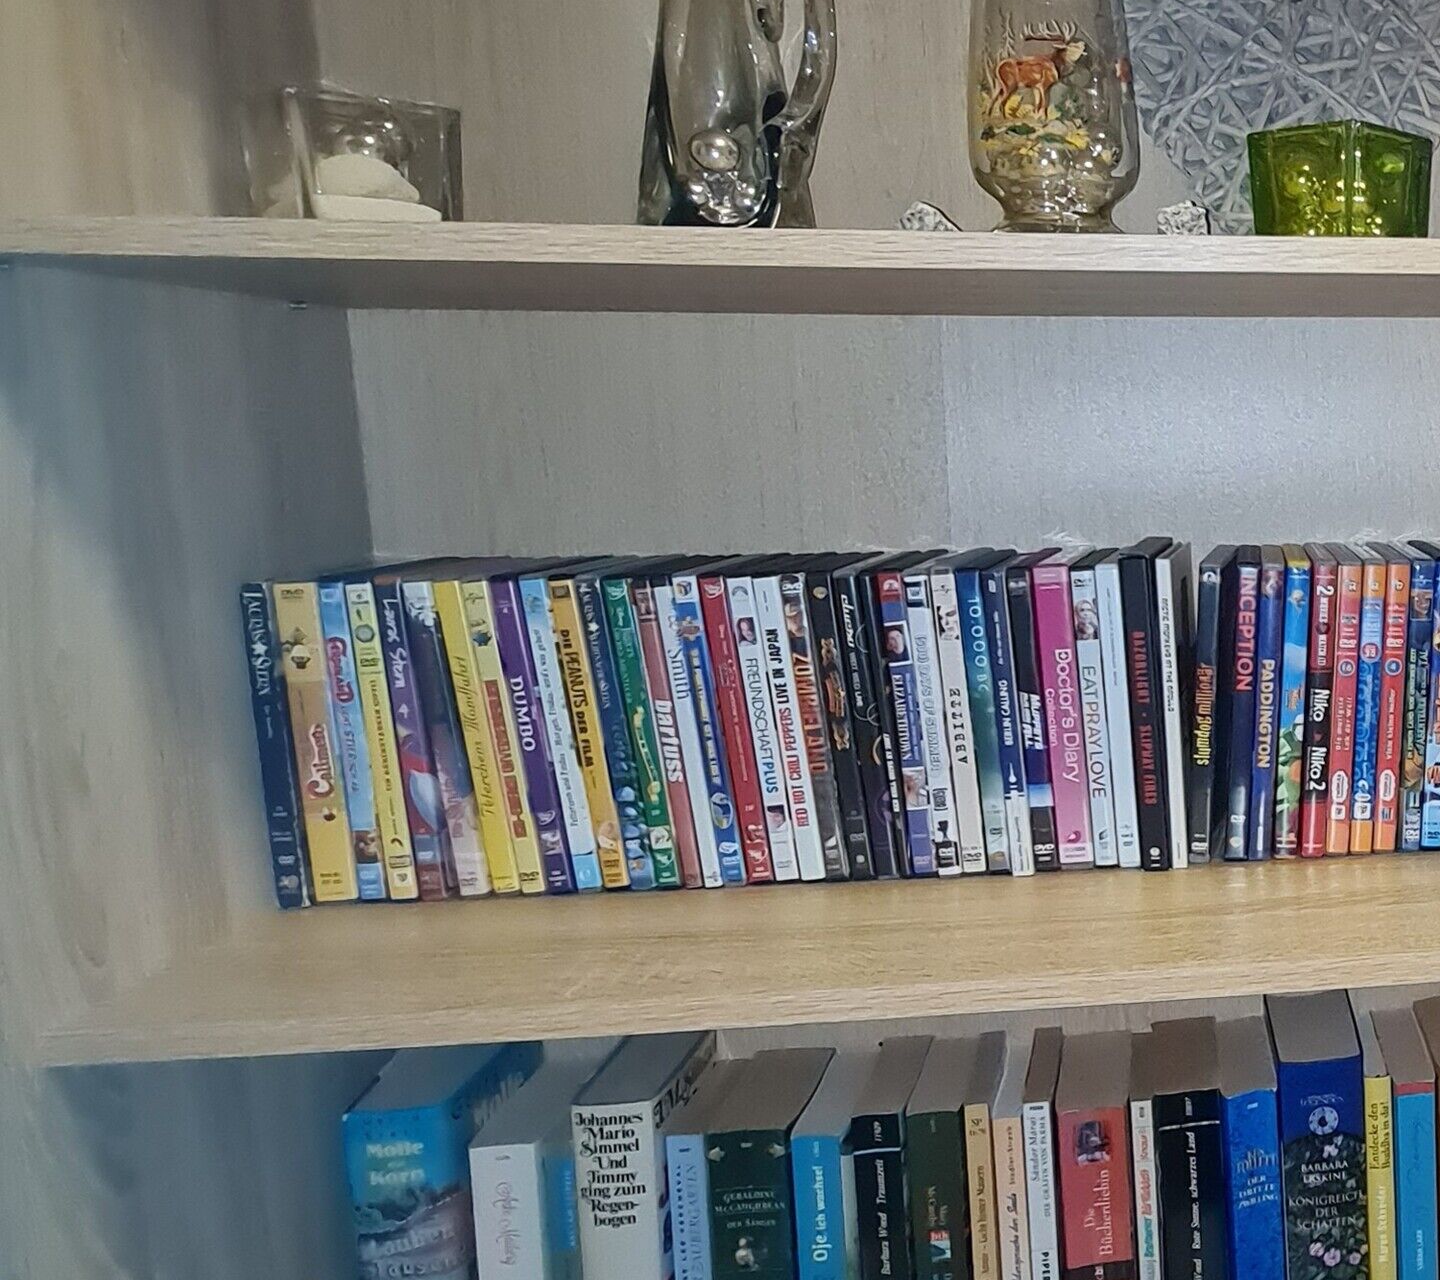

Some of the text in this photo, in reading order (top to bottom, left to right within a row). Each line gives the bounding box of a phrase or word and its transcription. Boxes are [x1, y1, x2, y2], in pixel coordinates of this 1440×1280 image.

[1316, 584, 1334, 596] 2
[382, 597, 408, 690] Lauras Stern
[968, 596, 987, 670] 10.000
[1235, 572, 1258, 691] INCEPTION
[668, 649, 689, 700] Smith
[509, 675, 537, 752] DUMBO
[560, 629, 593, 768] DIE PEANUTS DER FILM
[792, 652, 827, 773] ZOMBIELAND
[998, 679, 1015, 747] BERLIN CALLING
[1044, 688, 1058, 748] Collection
[1054, 648, 1081, 784] Doctor's Diary
[1256, 658, 1275, 769] PADDINGTON
[1311, 688, 1331, 722] Niko
[456, 655, 495, 816] Peterchens Mondfahrt
[655, 699, 683, 784] barfuss
[765, 628, 810, 828] RED HOT CHILI PEPPERS LIVE IN JAPAN
[950, 688, 969, 764] ABBITTE
[1193, 712, 1210, 766] slumdog
[1089, 751, 1107, 798] LOVE
[1309, 746, 1328, 791] Niko 2
[575, 1112, 644, 1126] Johannes
[586, 1126, 635, 1140] Mario
[1186, 1130, 1197, 1153] Land
[1368, 1101, 1379, 1170] Entdecke den
[581, 1140, 640, 1156] Simmel
[592, 1156, 628, 1169] Und
[1300, 1160, 1349, 1173] BARBARA
[580, 1183, 646, 1199] ging zum
[586, 1171, 638, 1186] Jimmy
[1302, 1171, 1347, 1184] ERSKINE
[587, 1198, 640, 1213] Regen-
[593, 1214, 637, 1228] bogen
[815, 1216, 827, 1233] ich
[1084, 1207, 1094, 1229] Die
[1296, 1216, 1357, 1230] SCHATTEN
[1314, 1206, 1339, 1218] DER
[880, 1240, 892, 1276] Barbara
